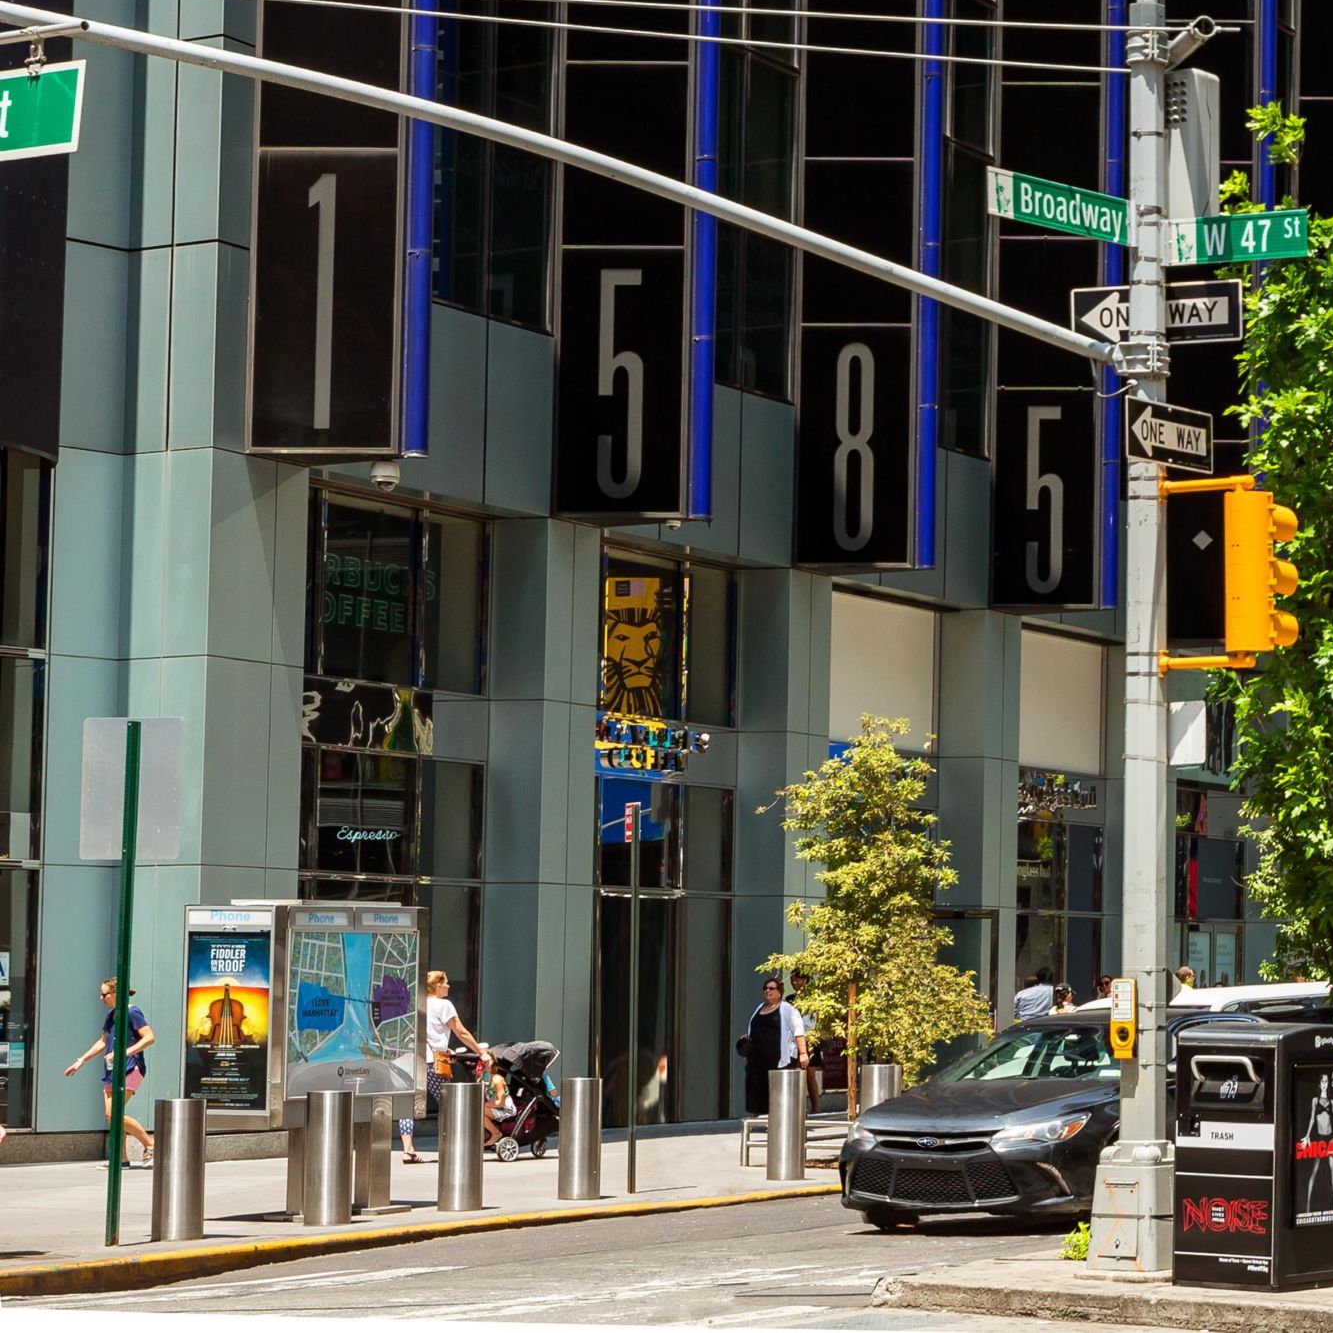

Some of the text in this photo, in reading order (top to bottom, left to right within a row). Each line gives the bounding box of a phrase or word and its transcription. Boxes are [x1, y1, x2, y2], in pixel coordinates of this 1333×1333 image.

[1020, 183, 1124, 243] Broadway
[1204, 216, 1301, 256] W 47 St
[1099, 300, 1219, 328] ON WAY
[1141, 420, 1202, 454] ONE WAY
[324, 591, 404, 633] OFFEE
[336, 826, 402, 843] Espresso
[210, 910, 251, 922] Phone
[308, 913, 335, 924] Phone
[373, 913, 399, 924] Phone
[210, 948, 247, 960] FIDDLER
[218, 960, 246, 972] ROOF
[1210, 1131, 1234, 1141] TRASH
[1183, 1196, 1268, 1234] NOISE
